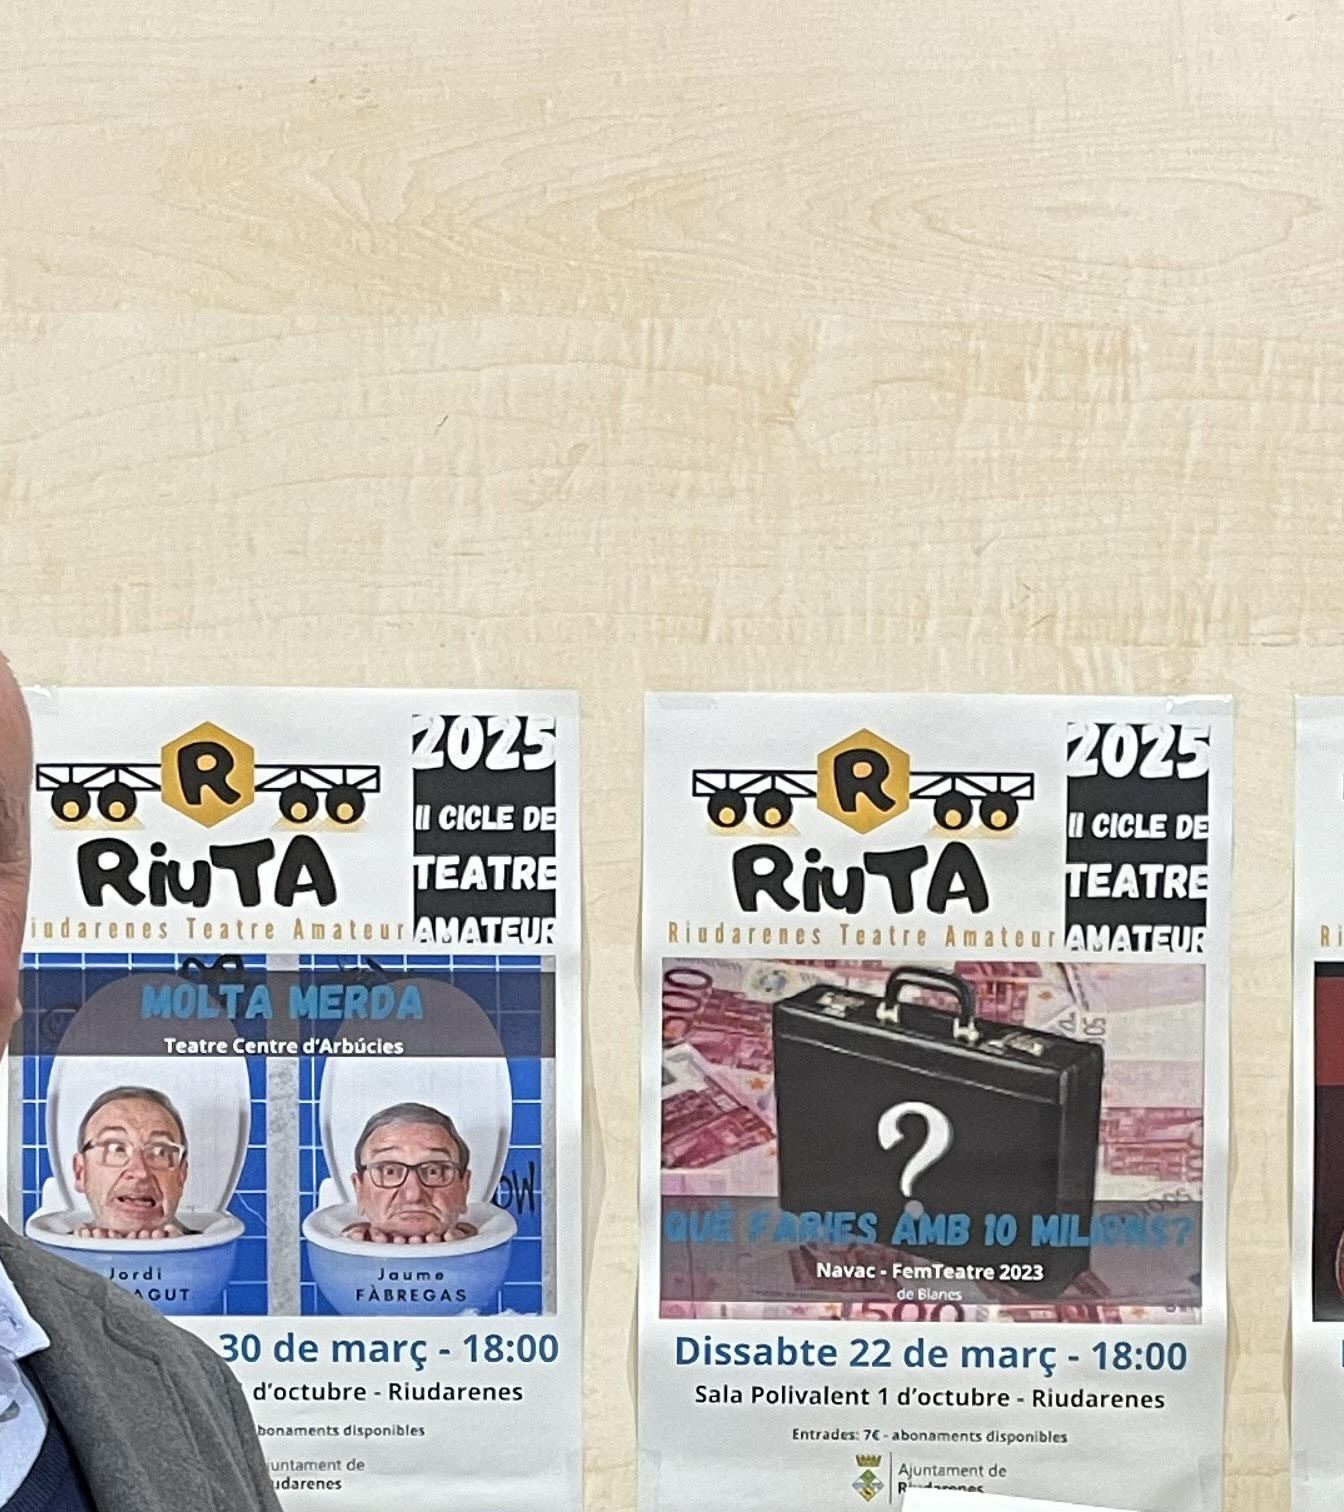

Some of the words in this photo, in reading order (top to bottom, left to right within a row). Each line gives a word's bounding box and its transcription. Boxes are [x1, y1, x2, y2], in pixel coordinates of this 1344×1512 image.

[413, 714, 556, 771] 2025
[1067, 721, 1210, 780] 2025
[177, 741, 242, 806] R
[834, 747, 897, 813] R
[415, 805, 430, 832] II
[439, 804, 515, 832] CICLE
[523, 804, 557, 832] DE
[1068, 813, 1085, 839] II
[1091, 812, 1167, 839] CICLE
[1176, 812, 1211, 840] DE
[76, 833, 338, 908] RiuTA
[413, 854, 557, 891] TEATRE
[731, 841, 990, 915] RiuTA
[1066, 862, 1209, 900] TEATRE
[31, 917, 170, 941] iudarenes
[186, 917, 275, 942] Teatre
[292, 917, 409, 942] Amateur
[413, 915, 556, 946] AMATEUR
[668, 921, 822, 946] Riudarenes
[839, 922, 927, 947] Teatre
[944, 923, 1057, 949] Amateur
[1065, 924, 1207, 953] AMATEUR
[141, 983, 273, 1021] MOLTA
[288, 983, 424, 1021] MERDA
[164, 1037, 228, 1055] Teatre
[232, 1037, 298, 1055] Centre
[748, 1210, 877, 1245] FARIES
[891, 1211, 971, 1247] AMB
[984, 1213, 1017, 1247] 10
[1031, 1213, 1195, 1249] MILIONS?
[109, 1266, 162, 1281] Jordi
[378, 1266, 444, 1282] Jaume
[816, 1262, 876, 1279] Navac
[892, 1263, 995, 1280] FemTeatre
[999, 1264, 1044, 1281] 2023
[356, 1281, 467, 1303] FÀBREGAS
[896, 1288, 914, 1301] de
[918, 1288, 963, 1302] Blanes
[219, 1333, 262, 1363] 30
[273, 1332, 320, 1363] de
[331, 1339, 428, 1370] març
[463, 1334, 559, 1363] 18:00
[675, 1336, 837, 1368] Dissabte
[849, 1338, 892, 1368] 22
[903, 1337, 950, 1369] de
[961, 1345, 1056, 1377] març
[1091, 1341, 1188, 1371] 18:00
[253, 1381, 367, 1402] d'octubre
[388, 1381, 524, 1402] Riudarenes
[694, 1385, 744, 1405] Sala
[751, 1385, 870, 1407] Polivalent
[878, 1388, 888, 1406] 1
[896, 1386, 1010, 1408] d'octubre
[1032, 1388, 1166, 1410] Riudarenes
[257, 1424, 340, 1438] bonaments
[343, 1423, 426, 1439] disponibles
[792, 1428, 860, 1442] Entrades:
[891, 1429, 982, 1444] abonaments
[986, 1429, 1068, 1446] disponibles
[268, 1459, 343, 1472] untament
[346, 1458, 366, 1472] de
[898, 1463, 984, 1479] Ajuntament
[988, 1463, 1007, 1478] de
[272, 1476, 343, 1491] udarenes
